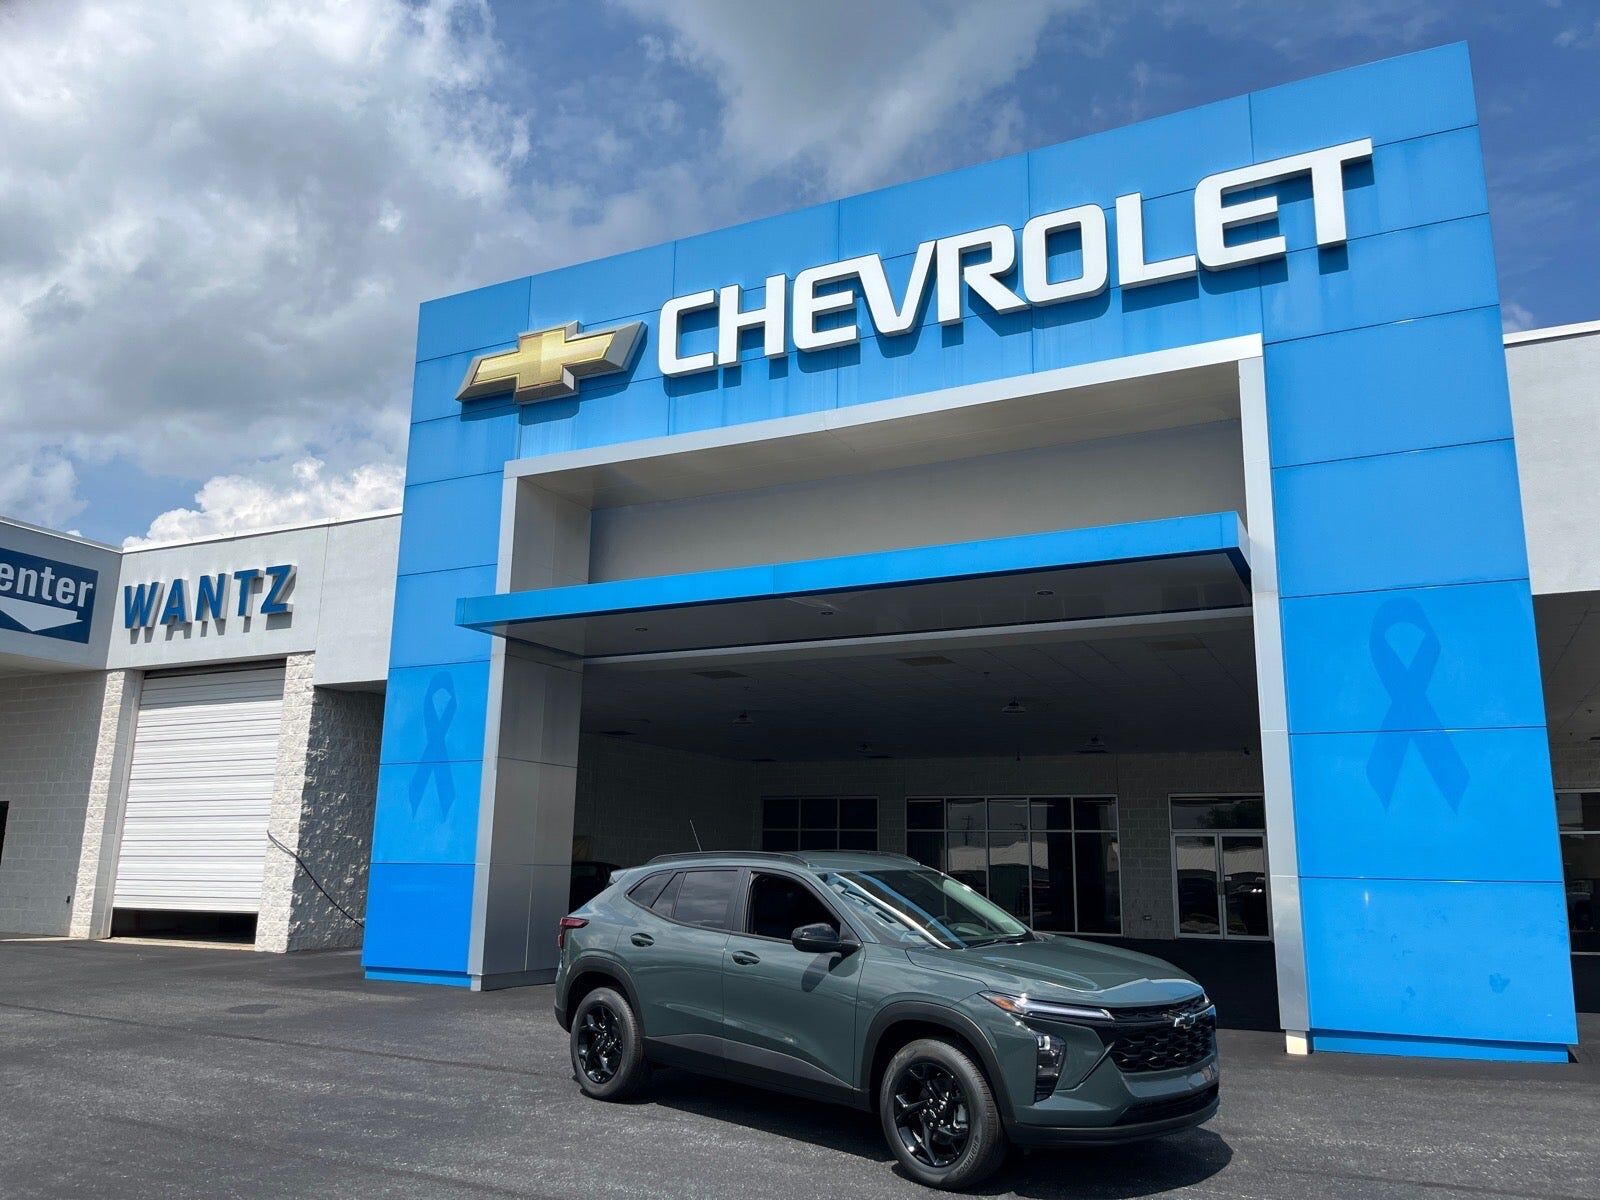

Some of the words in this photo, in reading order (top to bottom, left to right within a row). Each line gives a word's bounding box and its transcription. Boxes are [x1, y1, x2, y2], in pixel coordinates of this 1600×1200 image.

[659, 137, 1372, 376] CHEVROLET
[0, 562, 93, 608] enter
[124, 564, 297, 630] WANTZ
